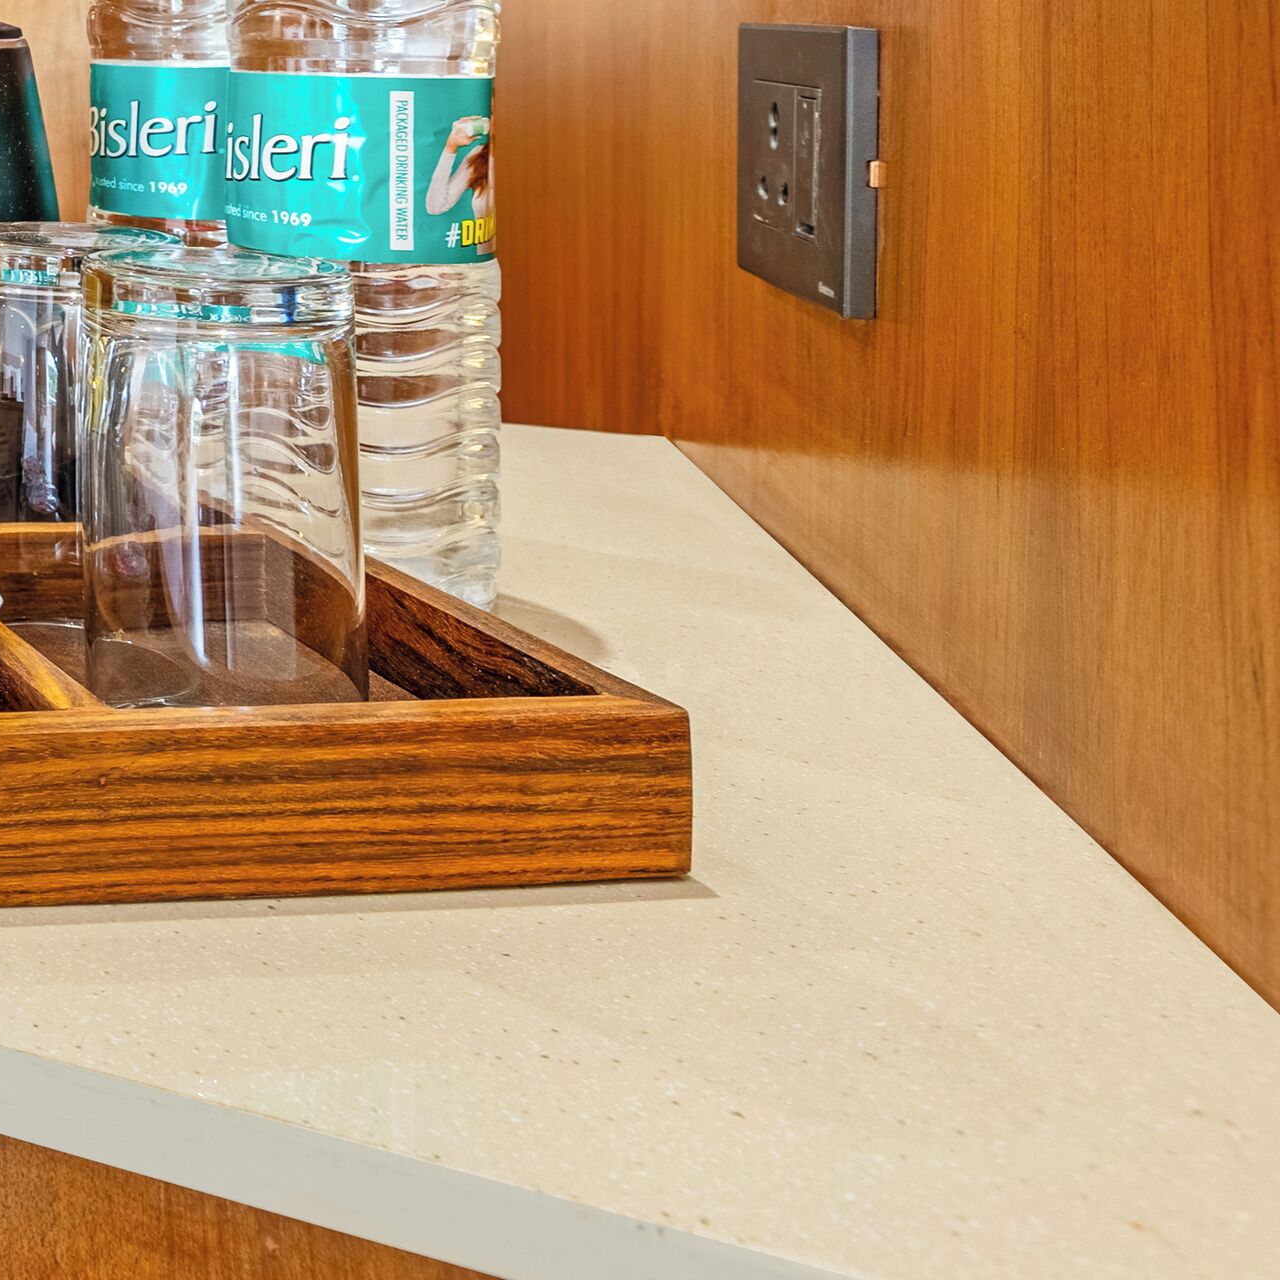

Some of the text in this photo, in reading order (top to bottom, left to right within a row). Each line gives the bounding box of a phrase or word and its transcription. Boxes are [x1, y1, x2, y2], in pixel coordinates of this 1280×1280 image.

[225, 113, 351, 182] isleri
[395, 100, 409, 241] PACKAGED DRINKING WATER
[118, 178, 145, 192] since
[148, 181, 188, 195] 1969
[242, 204, 268, 222] since
[271, 209, 313, 227] 1969
